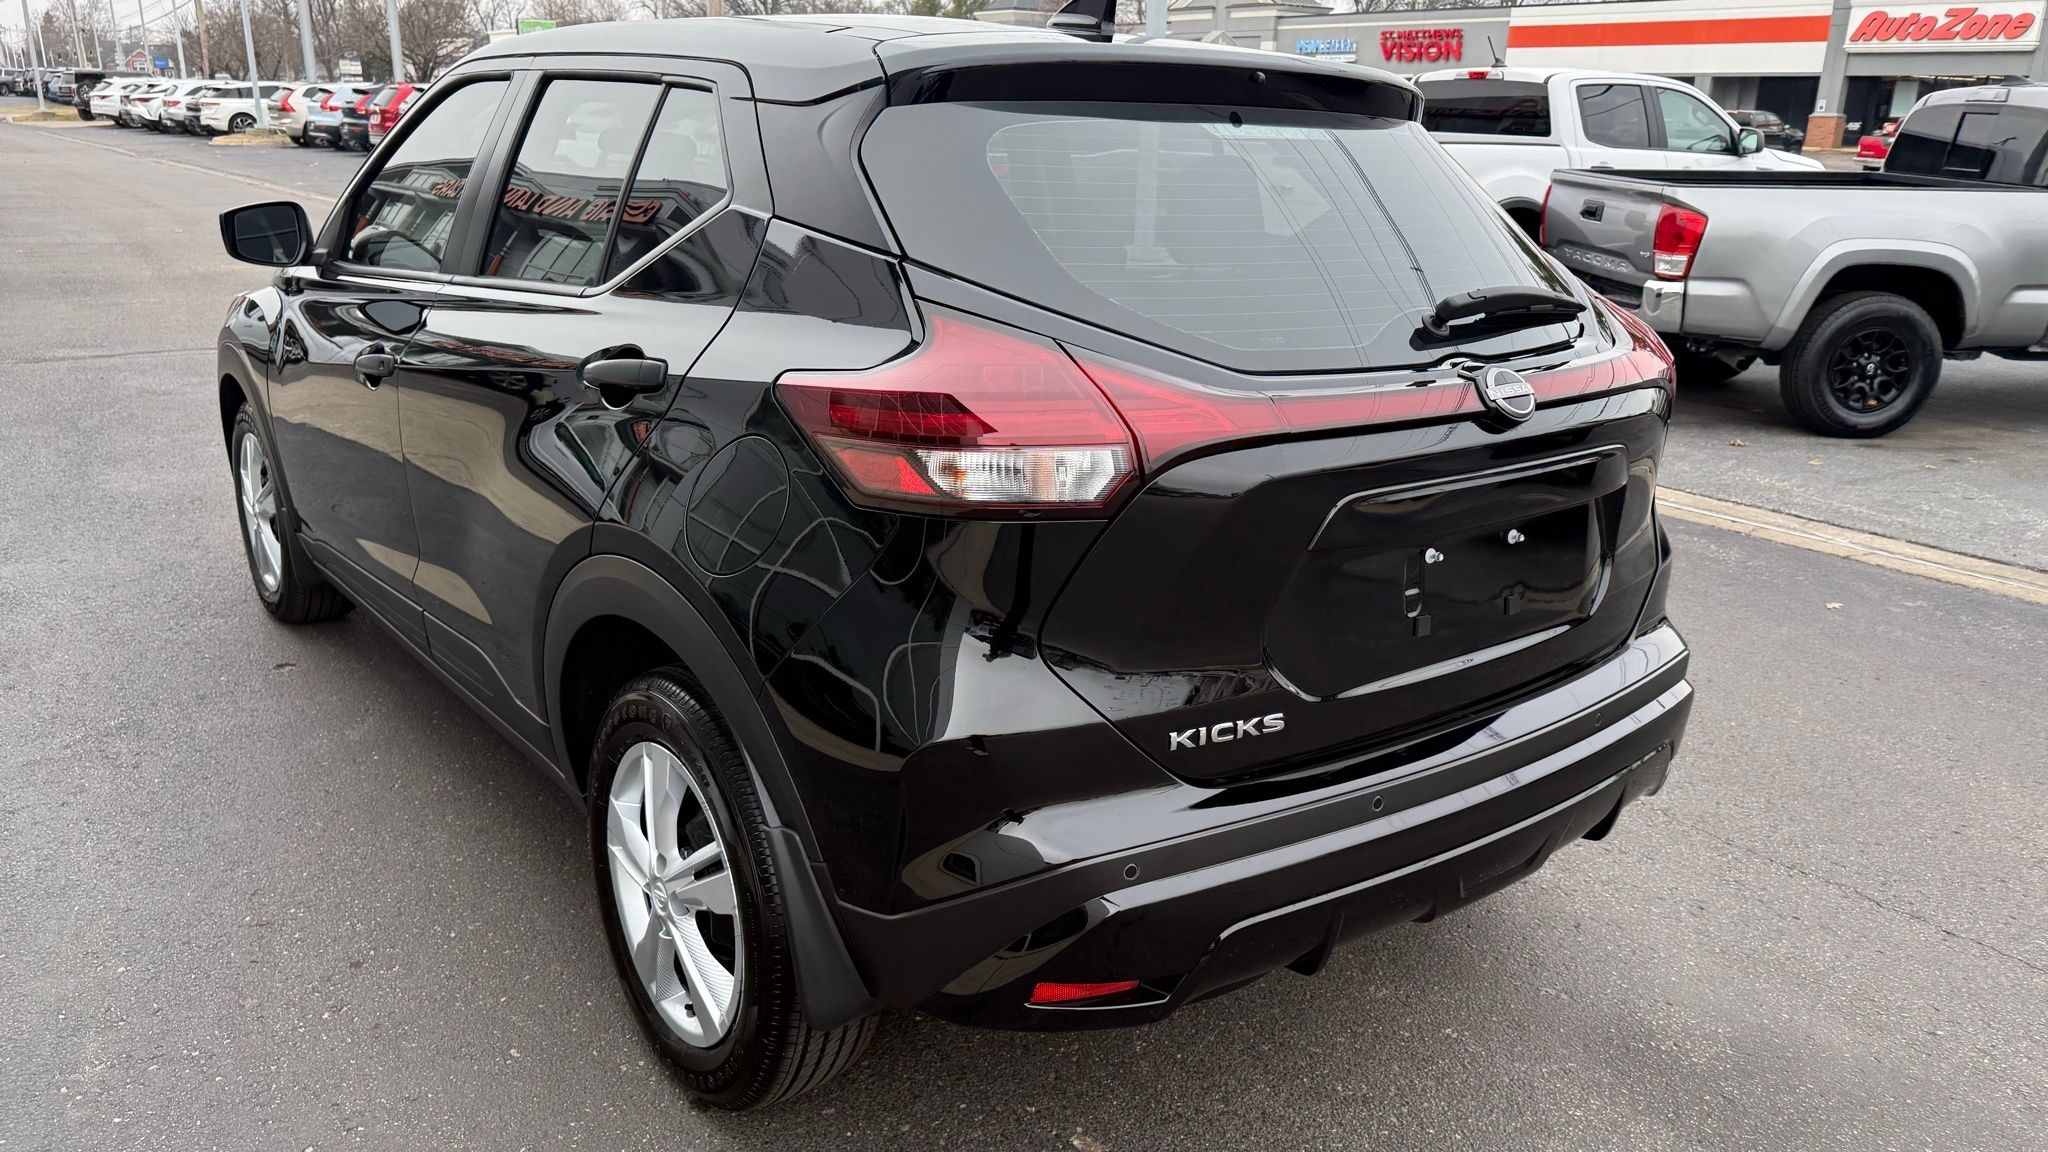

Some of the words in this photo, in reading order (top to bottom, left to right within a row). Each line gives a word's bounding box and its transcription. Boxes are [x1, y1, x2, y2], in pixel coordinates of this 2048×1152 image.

[1397, 28, 1463, 40] MATTHEWS
[1849, 7, 2036, 41] AutoZone
[1380, 40, 1463, 62] VISION
[1564, 247, 1630, 273] TACOMA
[1169, 713, 1285, 751] KICKS
